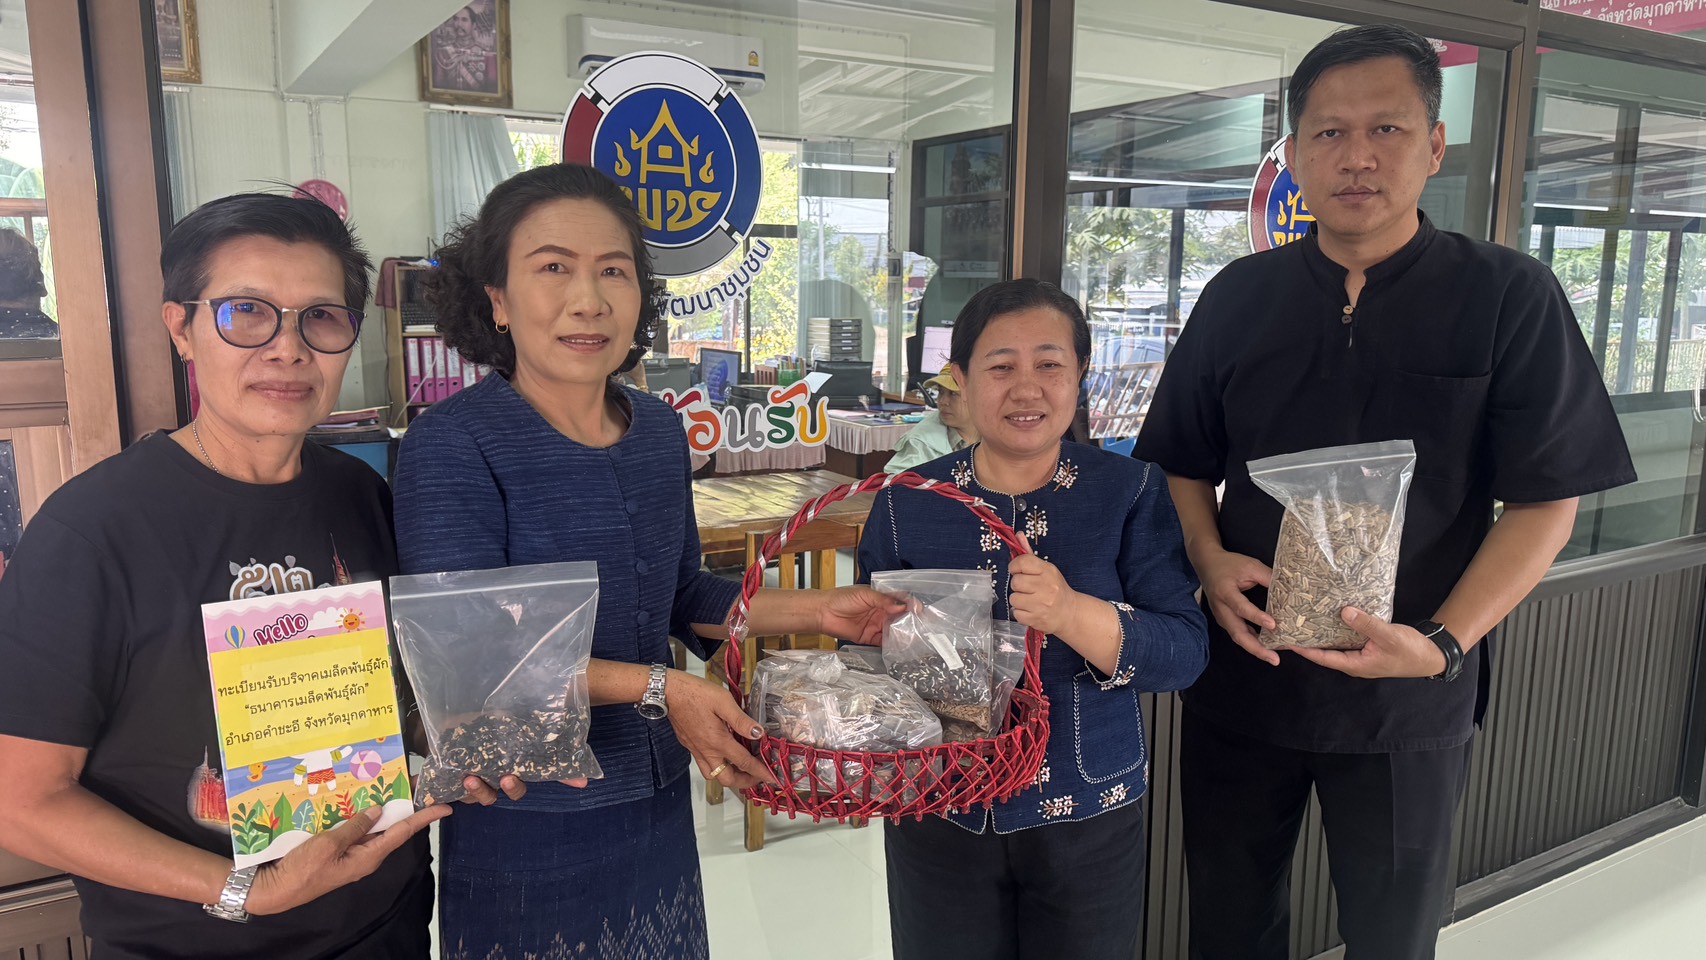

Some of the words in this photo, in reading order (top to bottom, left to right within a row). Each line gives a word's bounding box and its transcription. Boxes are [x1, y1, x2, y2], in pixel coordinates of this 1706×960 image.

[253, 613, 308, 646] Hello
[225, 719, 300, 746] อำเภอคำชะอี
[304, 703, 394, 730] จังหวัดมุกดาหาร
